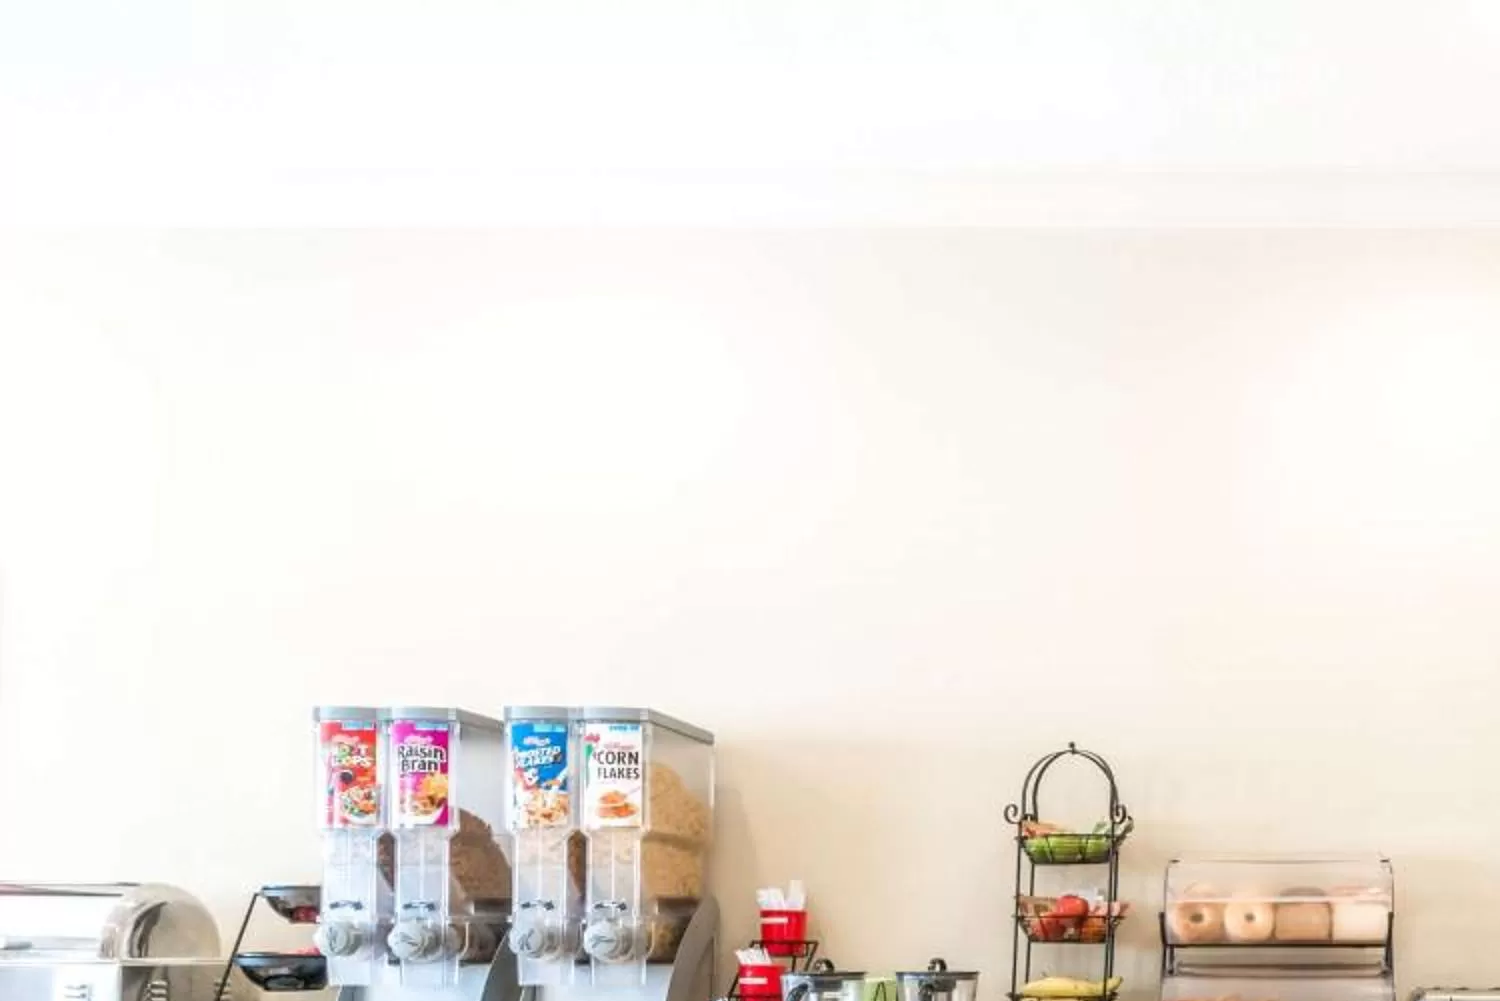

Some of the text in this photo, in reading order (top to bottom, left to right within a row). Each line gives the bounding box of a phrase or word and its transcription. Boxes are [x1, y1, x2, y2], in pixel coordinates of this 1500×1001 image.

[398, 744, 443, 760] Raisin
[597, 751, 639, 766] CORN
[401, 758, 438, 772] Bran
[597, 767, 640, 780] FLAKES
